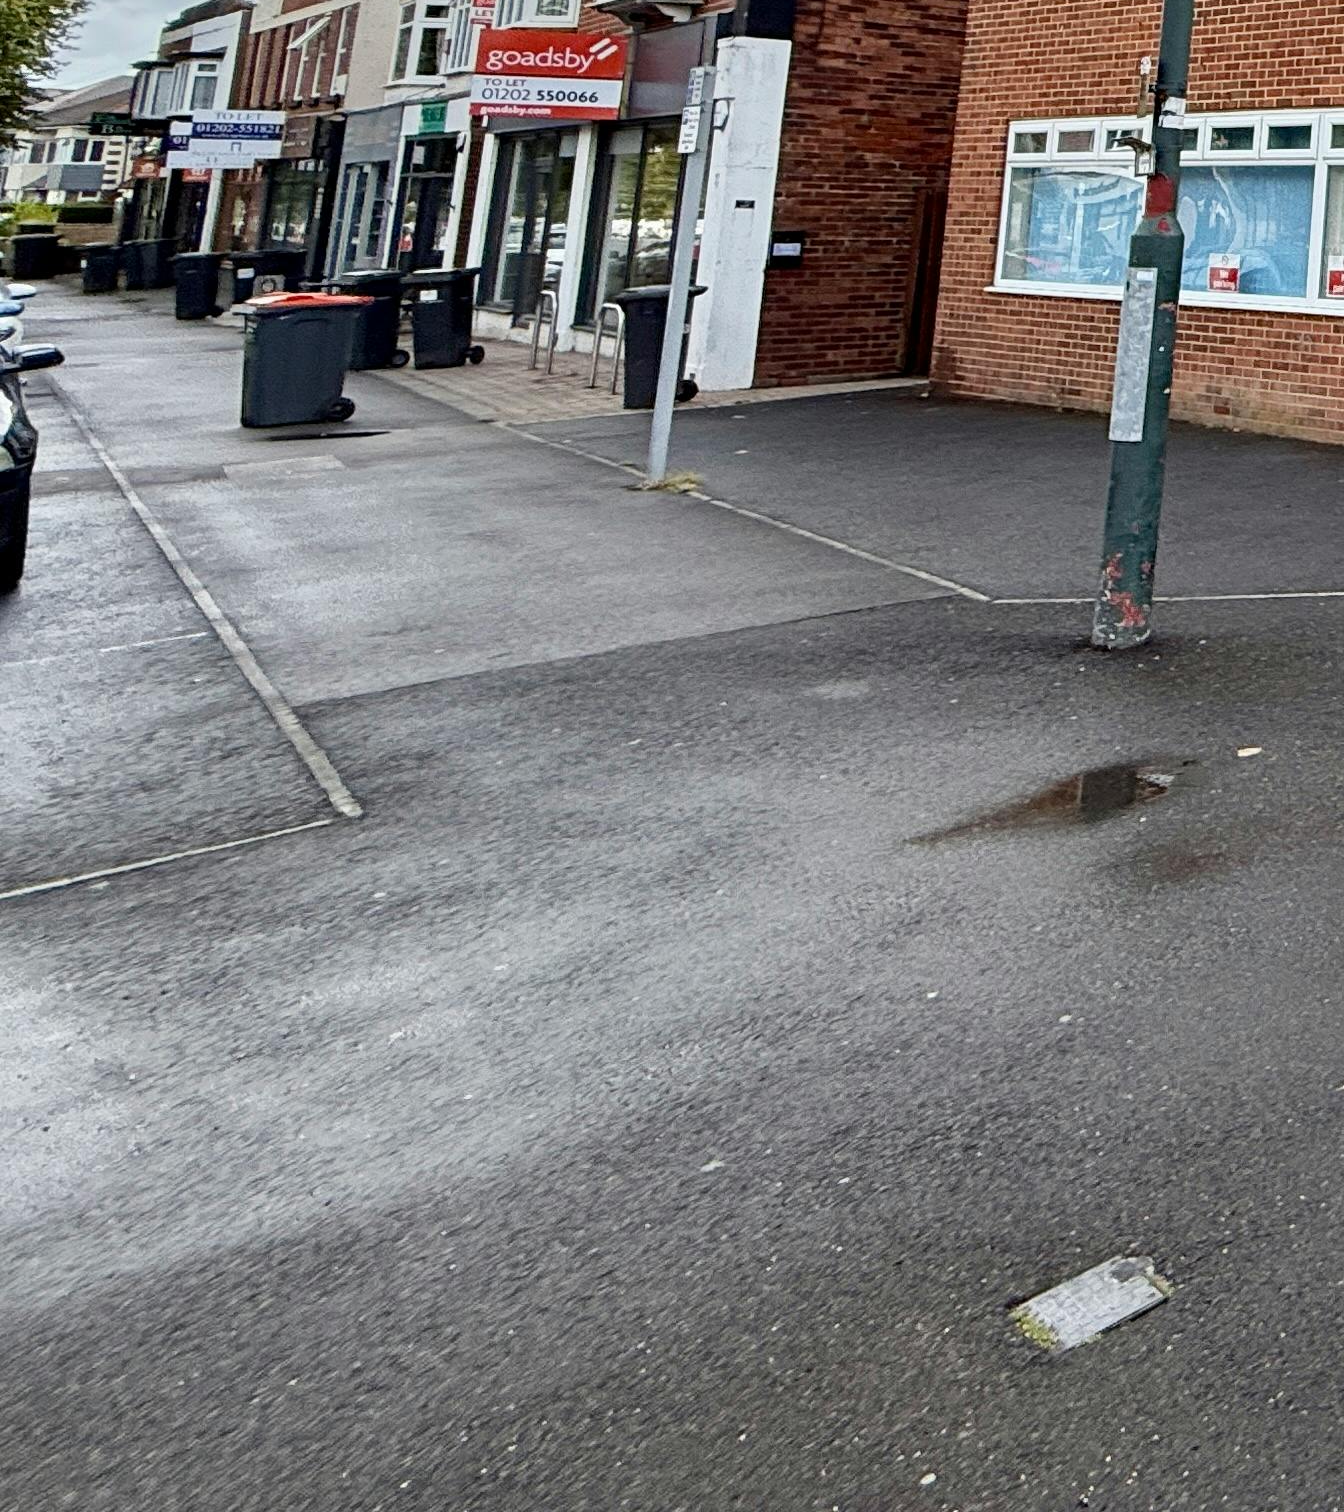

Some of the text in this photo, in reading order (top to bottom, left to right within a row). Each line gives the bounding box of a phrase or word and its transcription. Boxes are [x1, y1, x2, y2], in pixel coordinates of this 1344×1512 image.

[486, 46, 595, 73] goadsby
[484, 78, 527, 87] TO LET
[481, 88, 599, 103] 01202 550066
[480, 105, 552, 116] goadsby.com
